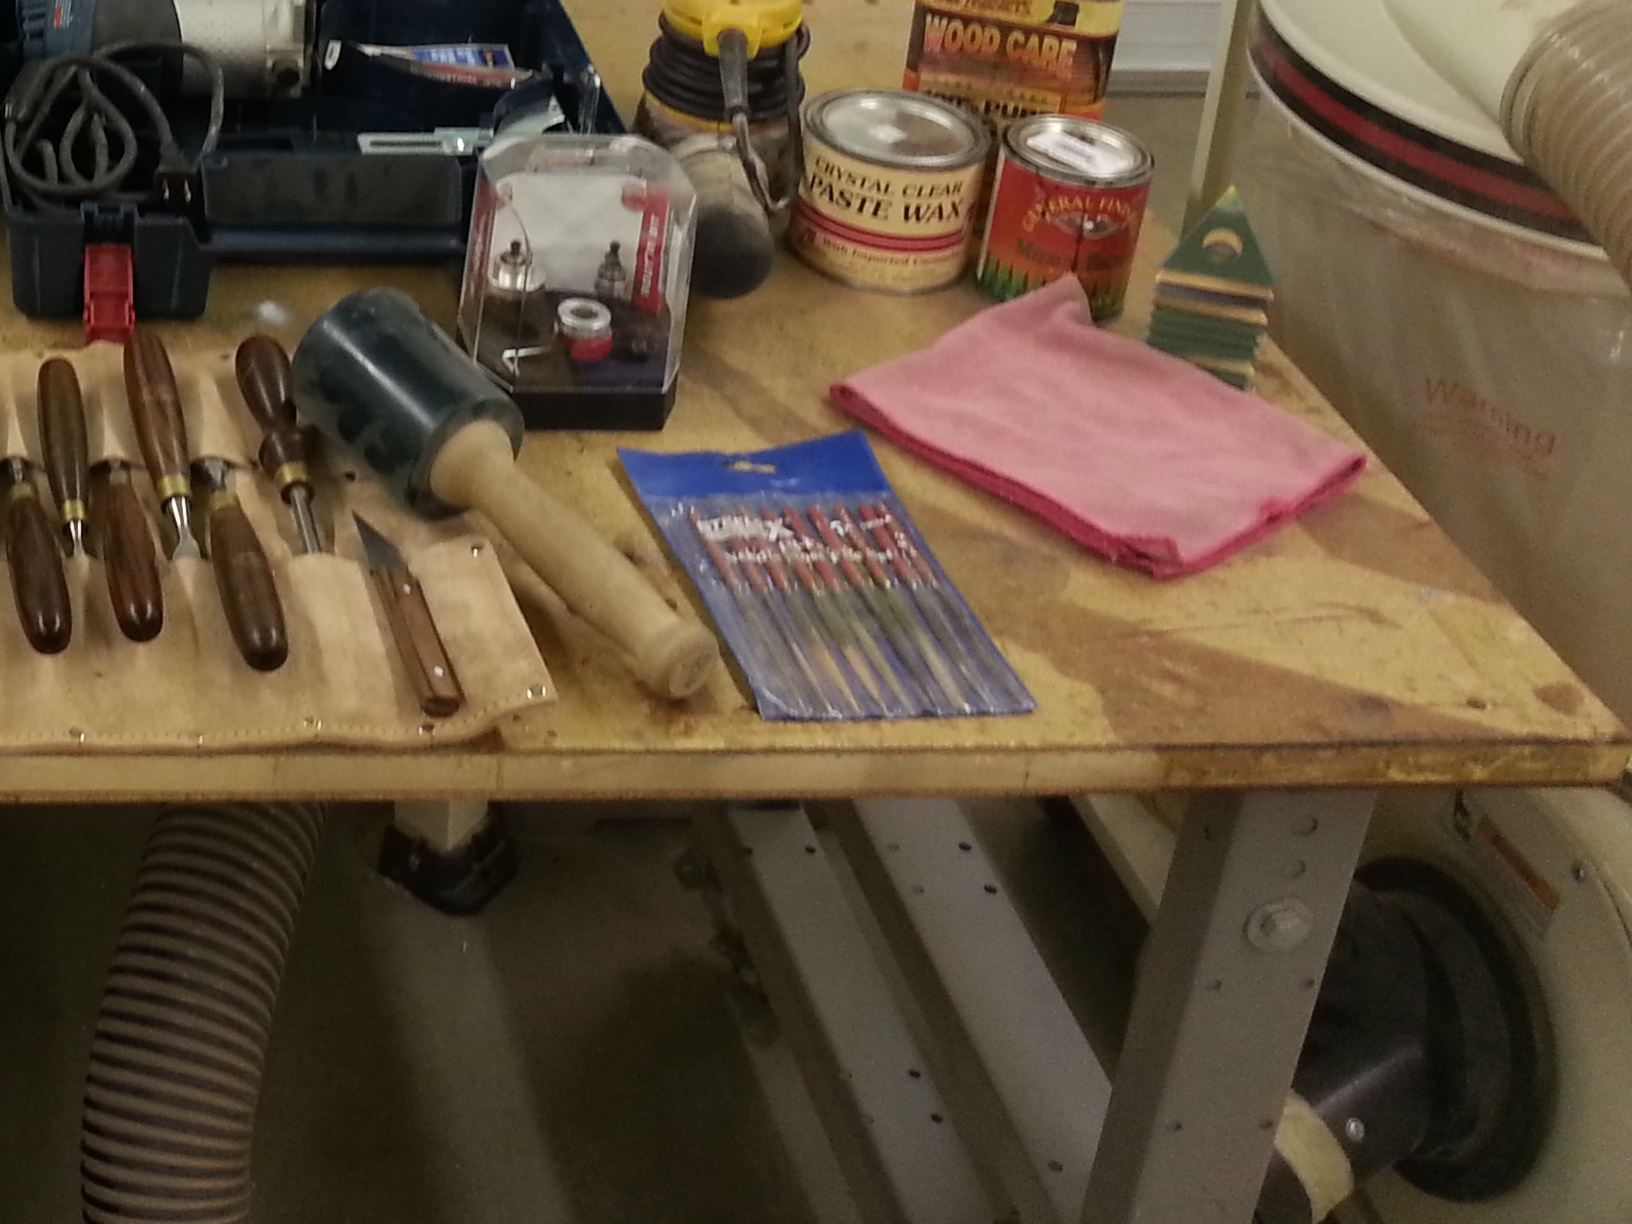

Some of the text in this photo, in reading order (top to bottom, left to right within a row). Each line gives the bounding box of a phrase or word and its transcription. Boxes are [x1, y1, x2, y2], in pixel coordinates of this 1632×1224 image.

[923, 13, 1078, 79] WOOD CARE
[809, 173, 964, 224] PASTE WAX
[815, 157, 963, 199] CRYSTAL CLEAR
[1424, 377, 1556, 458] Warning
